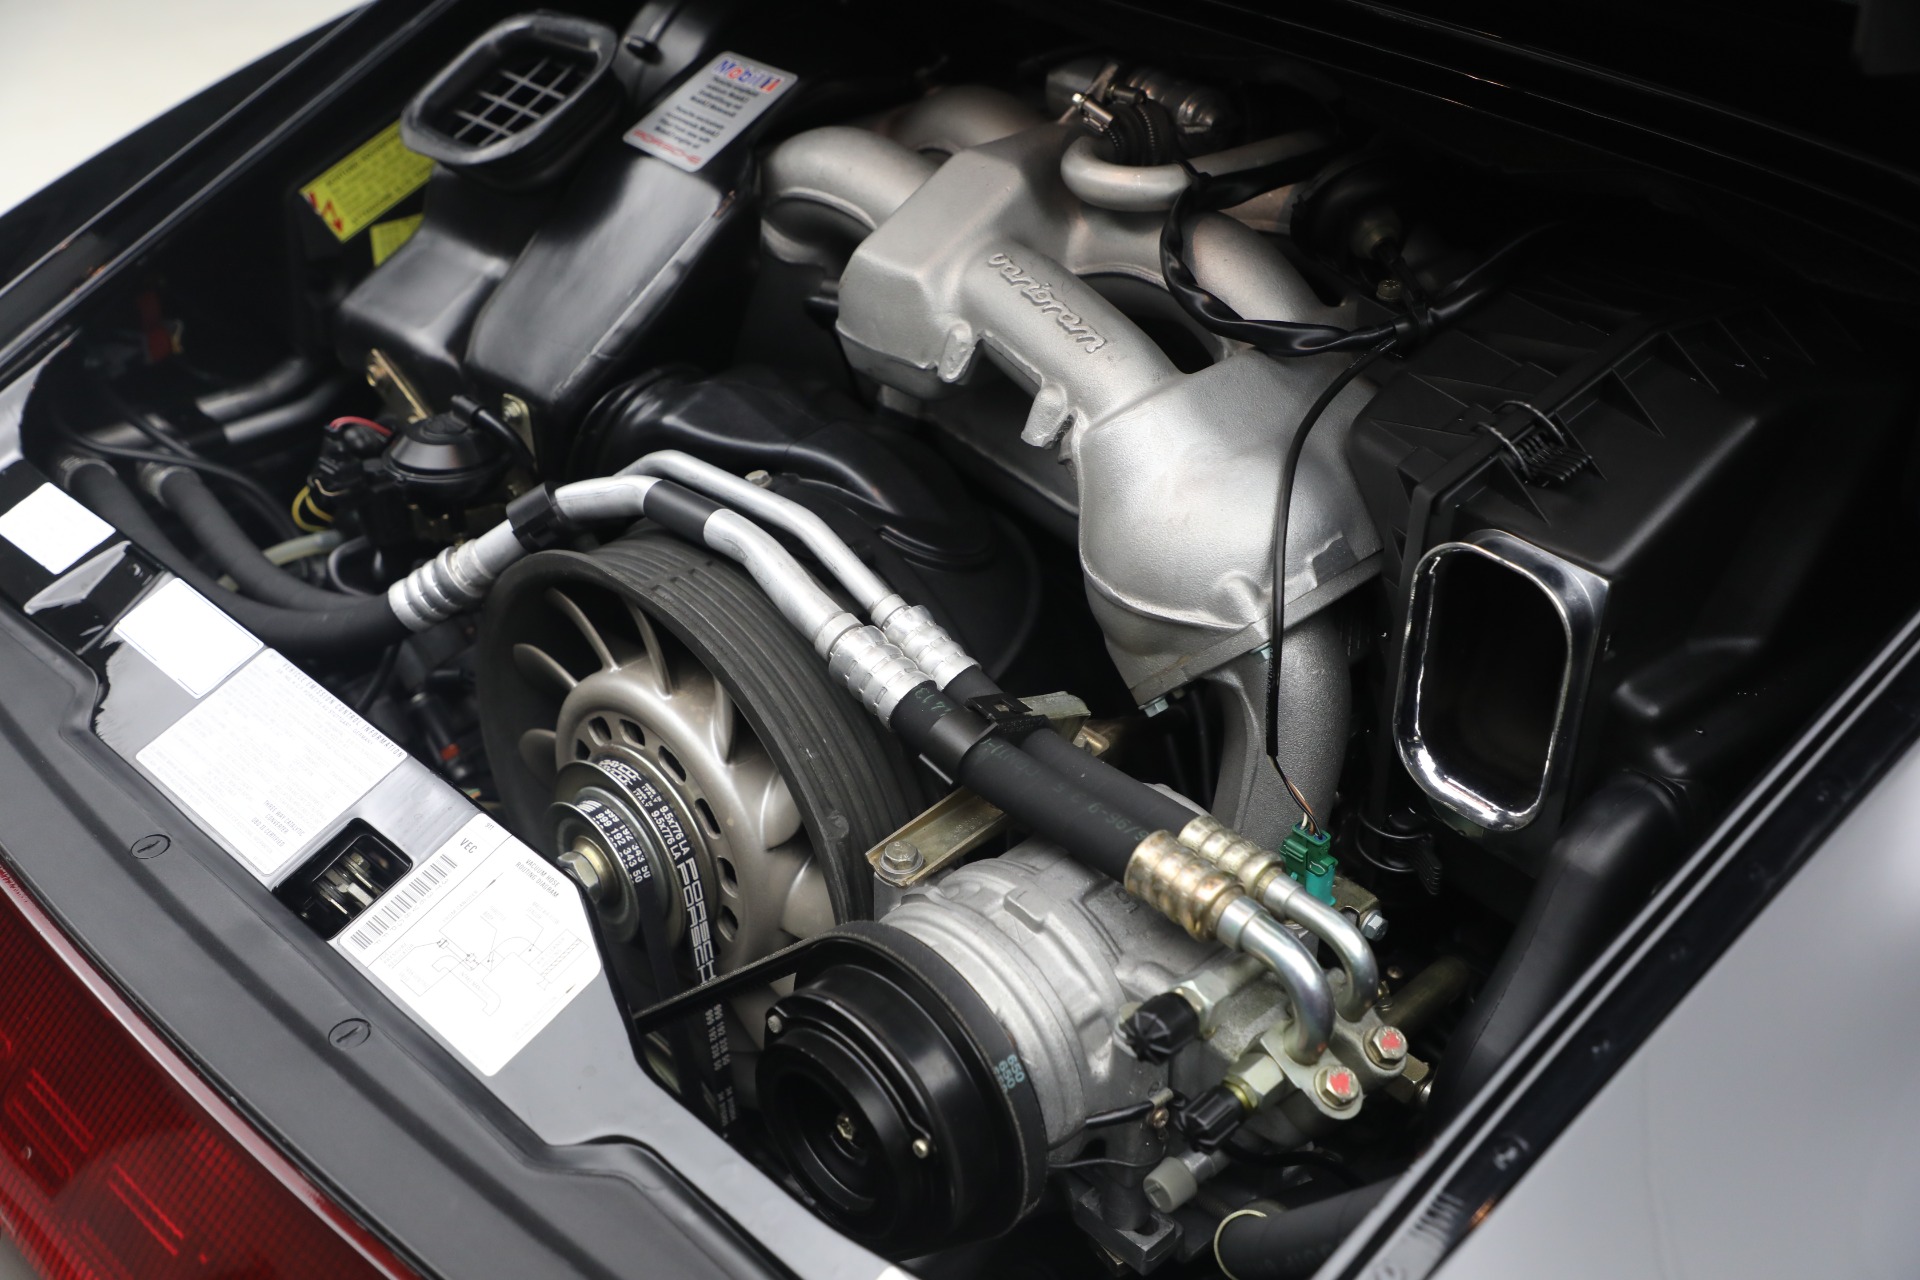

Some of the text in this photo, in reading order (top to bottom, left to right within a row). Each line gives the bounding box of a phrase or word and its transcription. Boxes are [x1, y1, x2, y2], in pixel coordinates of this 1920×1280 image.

[988, 252, 1107, 354] varioram
[282, 661, 405, 758] VEHICLE EMISSION CONTROL INFORMATION
[263, 828, 286, 848] CERTIFIED
[264, 813, 290, 833] CONVERTER
[650, 809, 682, 861] 9.5x776 LA
[659, 805, 691, 856] 9.5x776 LA
[459, 837, 478, 854] VEC
[595, 812, 613, 828] 999
[610, 828, 627, 846] 192
[622, 848, 638, 868] 343
[632, 869, 644, 883] 50
[515, 861, 560, 898] ROUTING DIAGRAM
[522, 858, 561, 888] VACUUM HOSE
[677, 862, 709, 985] PORSCH
[685, 857, 717, 980] PORSCH
[998, 1060, 1016, 1089] 650
[1007, 1054, 1025, 1083] 650
